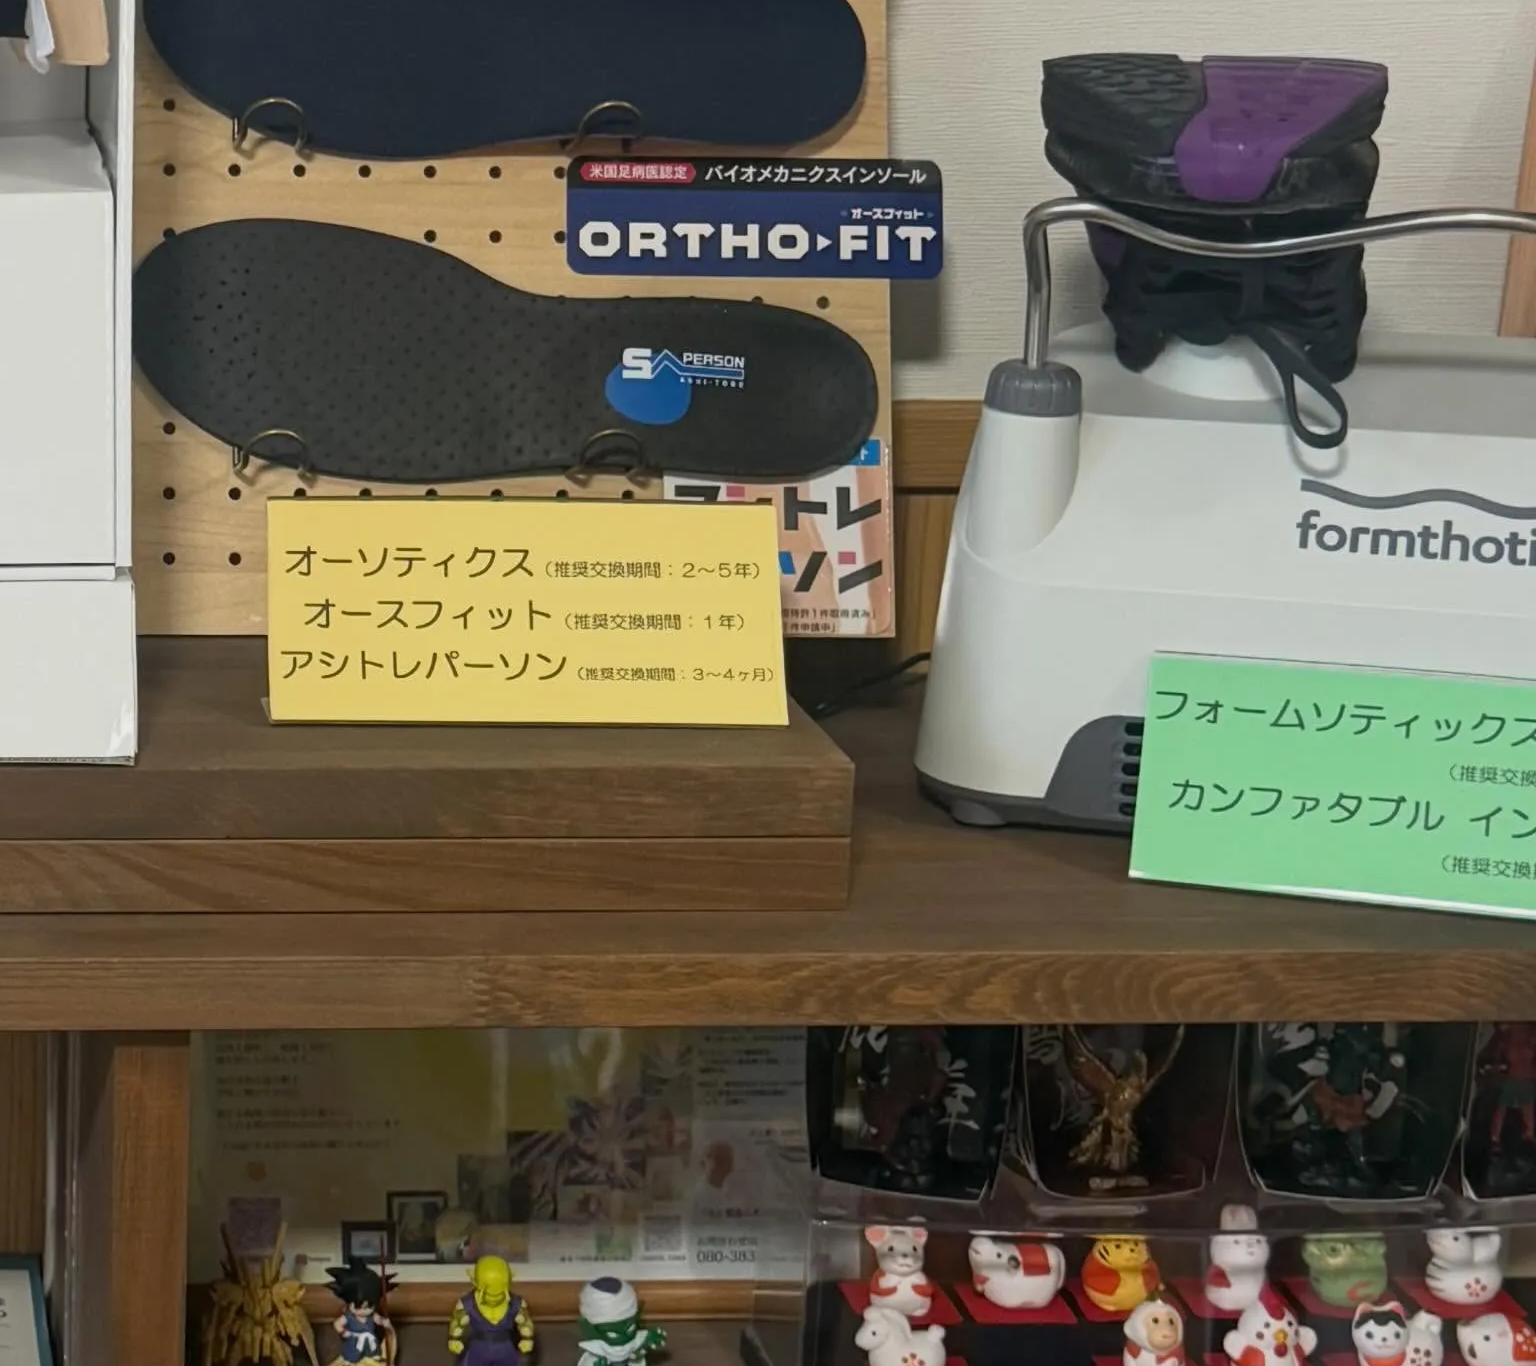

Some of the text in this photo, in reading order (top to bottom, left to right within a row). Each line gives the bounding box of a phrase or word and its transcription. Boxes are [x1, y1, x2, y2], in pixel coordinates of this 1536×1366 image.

[589, 164, 927, 185] 米国足病医認定 バイオメカニクスインソール
[850, 207, 925, 220] オースフィット
[682, 352, 745, 370] PERSON
[283, 545, 536, 579] オーソティクス
[302, 599, 553, 632] オースフィット
[279, 648, 567, 682] アシトレパーソン
[1168, 778, 1445, 832] カンファタブル
